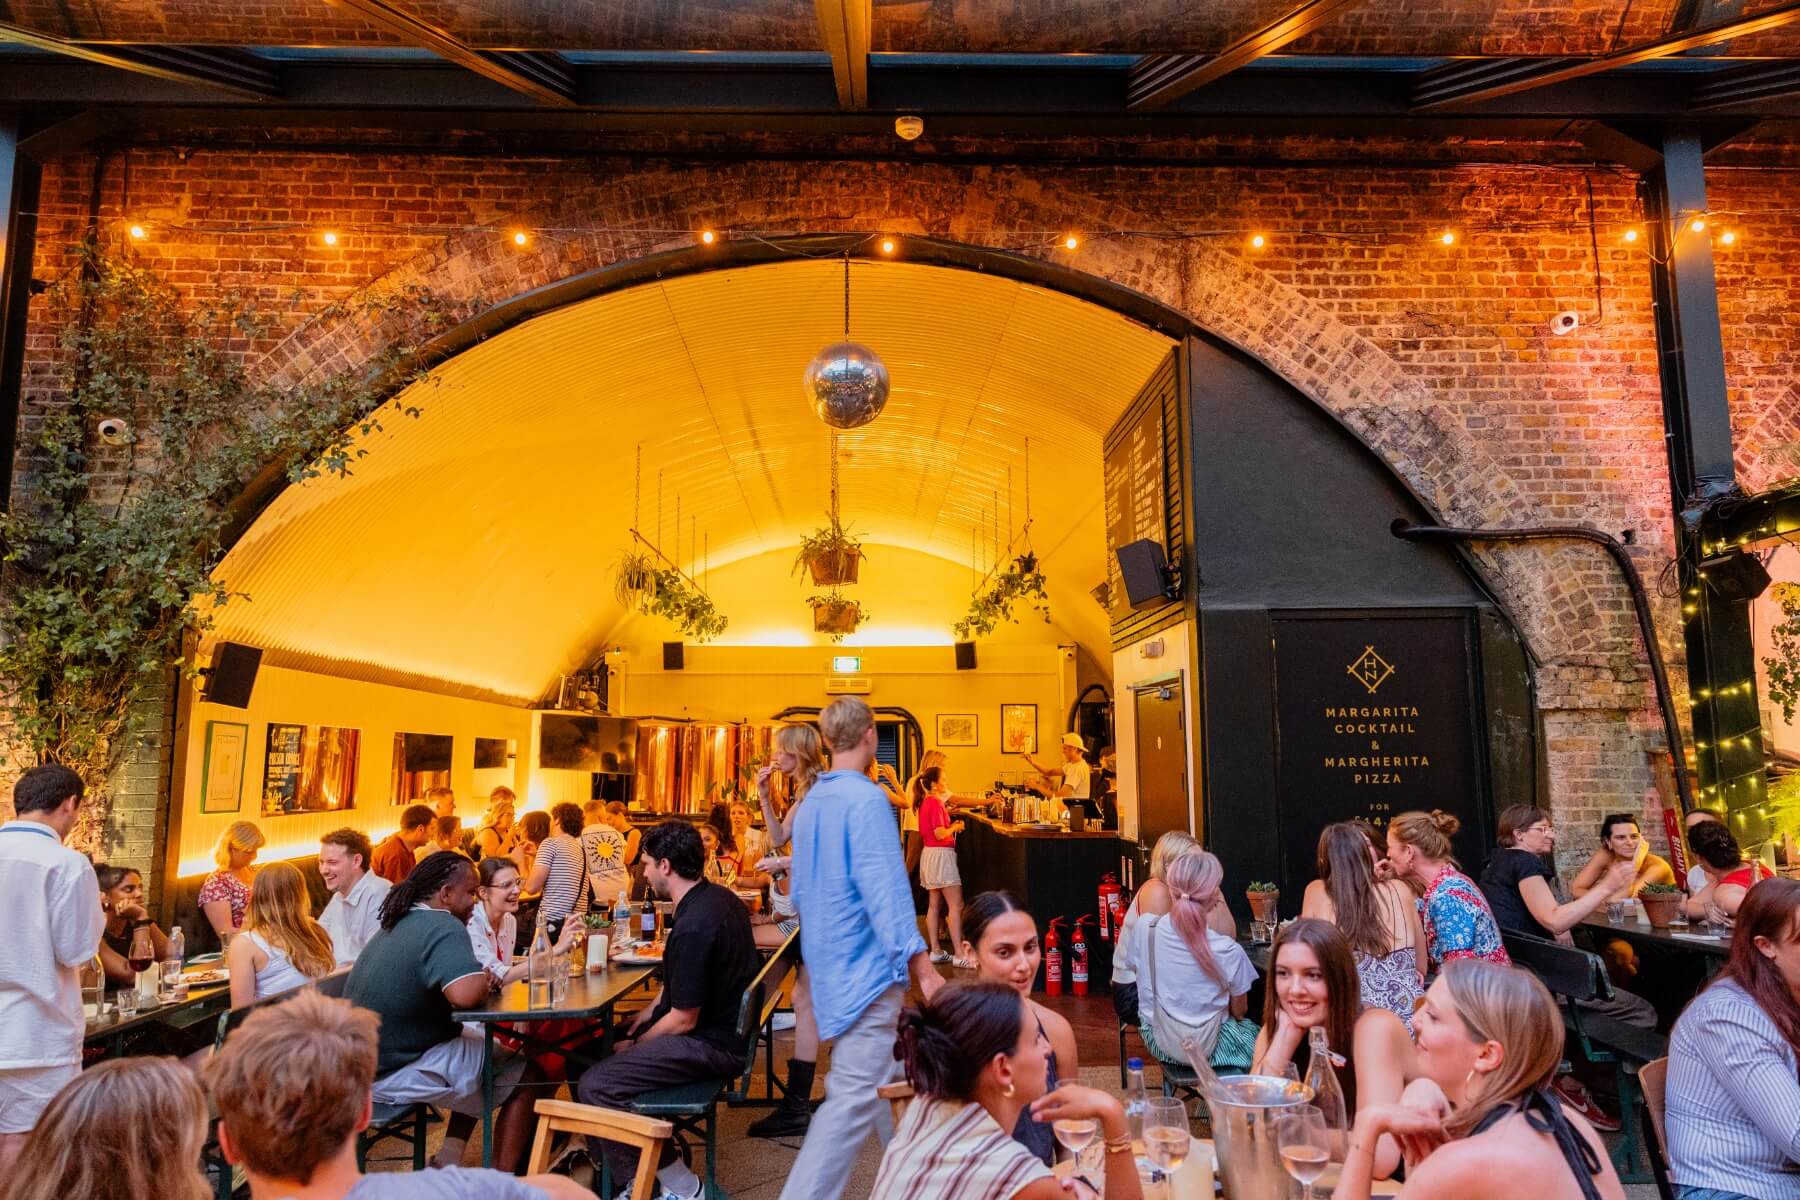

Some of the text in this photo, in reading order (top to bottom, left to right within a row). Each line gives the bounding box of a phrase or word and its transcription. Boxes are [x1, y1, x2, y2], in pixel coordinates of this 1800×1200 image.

[1326, 707, 1419, 718] MARGARITA
[1335, 723, 1415, 734] COCKTAIL
[1371, 740, 1380, 750] &
[1325, 757, 1429, 767] MARGHERITA
[1354, 774, 1401, 784] PIZZA
[1369, 803, 1390, 811] FOR
